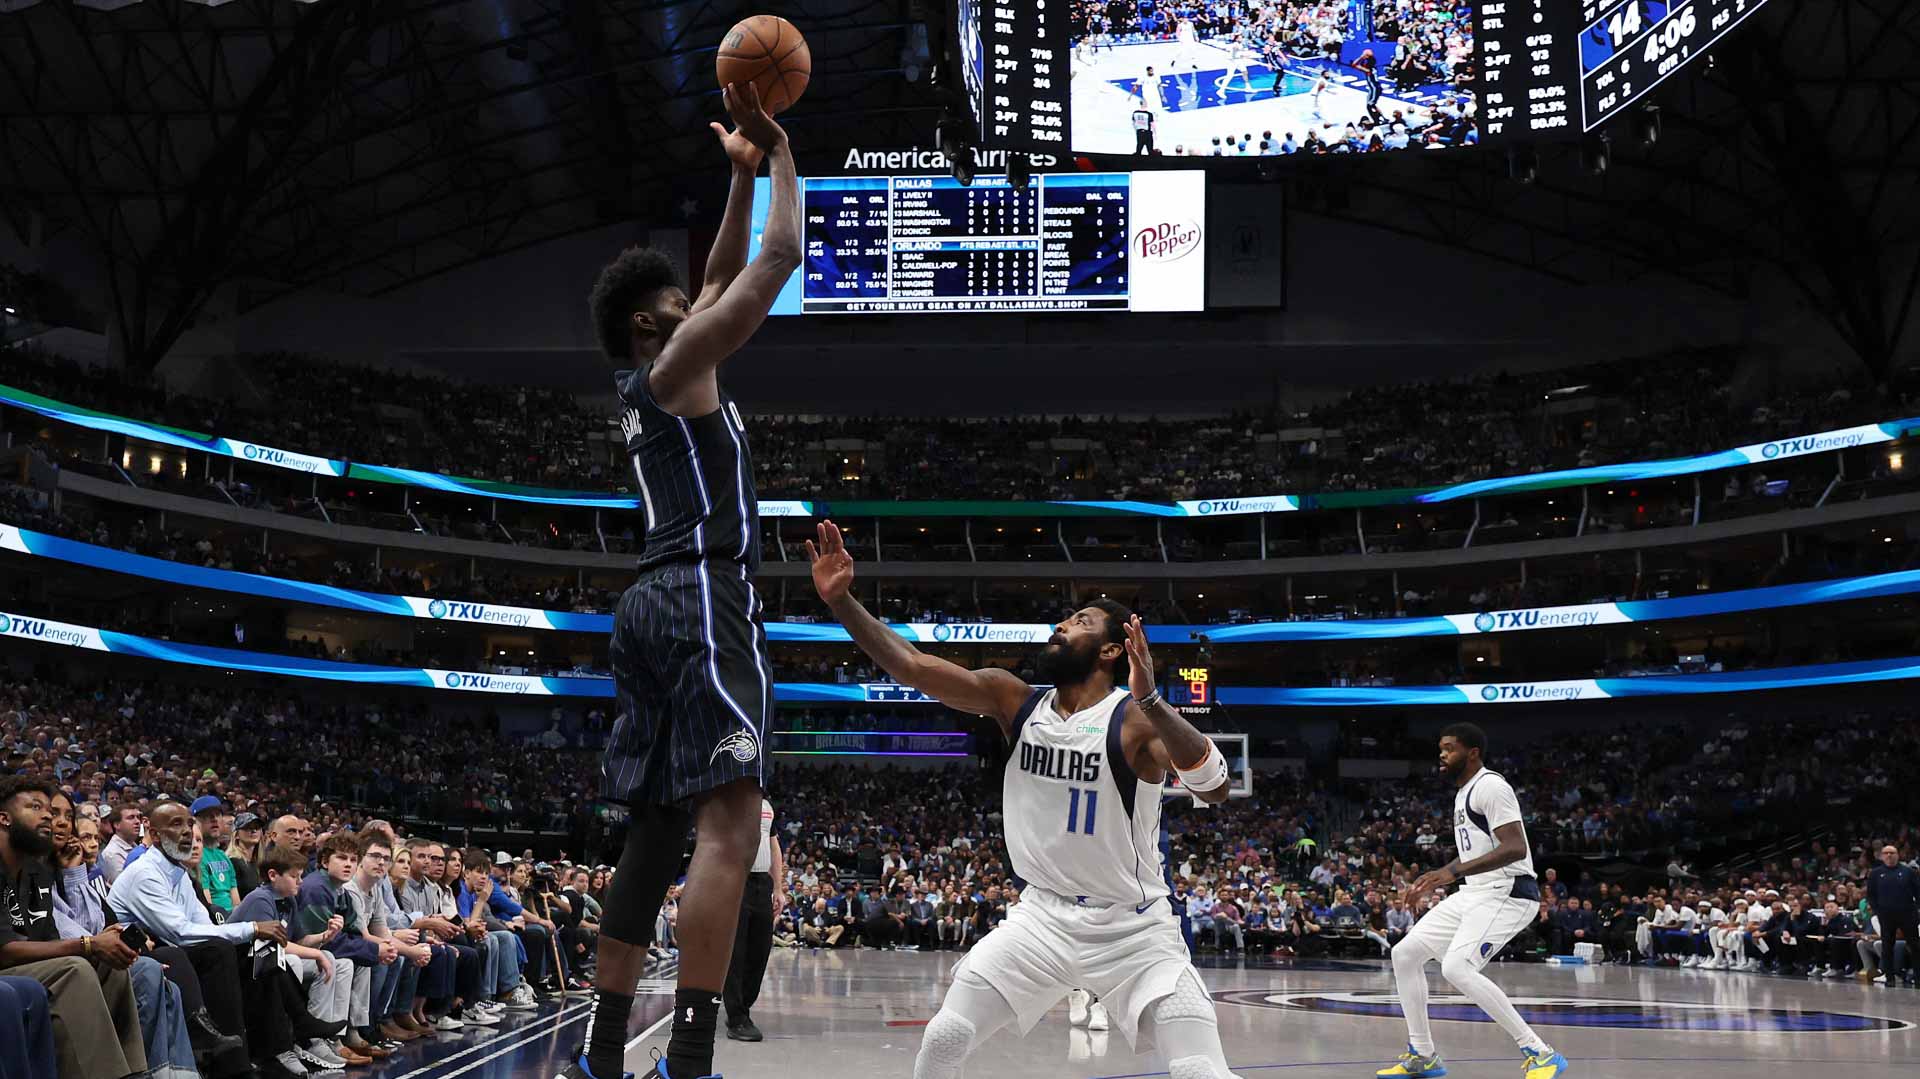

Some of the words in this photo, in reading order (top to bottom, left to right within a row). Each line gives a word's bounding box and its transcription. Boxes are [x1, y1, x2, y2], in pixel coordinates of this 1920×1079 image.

[994, 7, 1015, 20] BLK
[1037, 13, 1045, 24] 1
[1481, 3, 1506, 15] BLK
[1482, 18, 1504, 30] STL
[1532, 12, 1543, 24] 0
[1607, 0, 1642, 47] 14
[1711, 9, 1730, 31] FLS
[994, 22, 1014, 34] STL
[1036, 27, 1046, 38] 3
[1643, 6, 1697, 63] 4:06
[1483, 40, 1501, 52] FG
[1525, 34, 1553, 47] 6/12
[994, 44, 1010, 55] FG
[1030, 48, 1053, 60] 7/16
[1484, 53, 1512, 67] 3-PT
[1530, 49, 1550, 61] 1/3
[994, 59, 1018, 71] 3-PT
[1033, 63, 1050, 75] 1/4
[1657, 53, 1679, 76] QTR
[1681, 45, 1689, 59] 1
[994, 73, 1009, 85] FT
[1485, 70, 1501, 82] FT
[1531, 64, 1551, 76] 1/2
[1595, 70, 1616, 90] TOL
[1620, 59, 1631, 74] 6
[994, 95, 1010, 107] FG
[1486, 92, 1503, 104] FG
[1528, 85, 1566, 100] 50.0%
[1598, 92, 1617, 113] FLS
[1622, 82, 1632, 97] 2
[994, 110, 1019, 123] 3-PT
[1487, 106, 1515, 119] 3-PT
[994, 125, 1009, 136] FT
[1487, 122, 1503, 135] FT
[1530, 115, 1568, 130] 50.0%
[844, 146, 951, 169] America
[895, 179, 933, 189] DALLAS
[842, 196, 859, 204] DAL
[868, 195, 885, 204] ORL
[893, 191, 899, 199] 2
[1085, 192, 1102, 200] DAL
[1106, 192, 1124, 200] ORL
[894, 200, 902, 208] 11
[902, 200, 928, 208] IRVING
[902, 209, 941, 217] MARSHALL
[1043, 207, 1085, 215] REBOUNDS
[1043, 219, 1072, 227] STEALS
[893, 228, 902, 236] 77
[1043, 231, 1073, 239] BLOCKS
[1157, 222, 1181, 241] Dr
[895, 242, 942, 250] ORLANDO
[960, 241, 974, 249] PTS
[975, 241, 990, 249] REB
[990, 241, 1006, 249] AST
[1006, 241, 1020, 249] STL
[1022, 241, 1037, 249] FLS
[1047, 243, 1066, 251] FAST
[1141, 227, 1197, 258] Pepper
[902, 253, 924, 261] ISAAC
[1043, 251, 1070, 259] BREAK
[1043, 259, 1070, 267] POINTS
[808, 273, 823, 281] FTS
[902, 271, 934, 279] HOWARD
[1043, 271, 1070, 279] POINTS
[902, 280, 934, 288] WAGNER
[902, 289, 934, 297] WAGNER
[846, 303, 866, 311] GET
[868, 302, 895, 311] YOUR
[898, 302, 924, 310] MAVS
[927, 302, 954, 310] GEAR
[957, 301, 971, 310] ON
[973, 301, 987, 310] AT
[633, 452, 656, 532] 1
[1178, 668, 1208, 682] 4:05
[903, 692, 910, 700] 2
[1190, 681, 1206, 704] 9
[1180, 706, 1212, 714] TISSOT
[1076, 722, 1106, 735] chime
[1020, 741, 1102, 782] DALLAS
[1067, 786, 1099, 837] 11
[1458, 827, 1472, 853] 13
